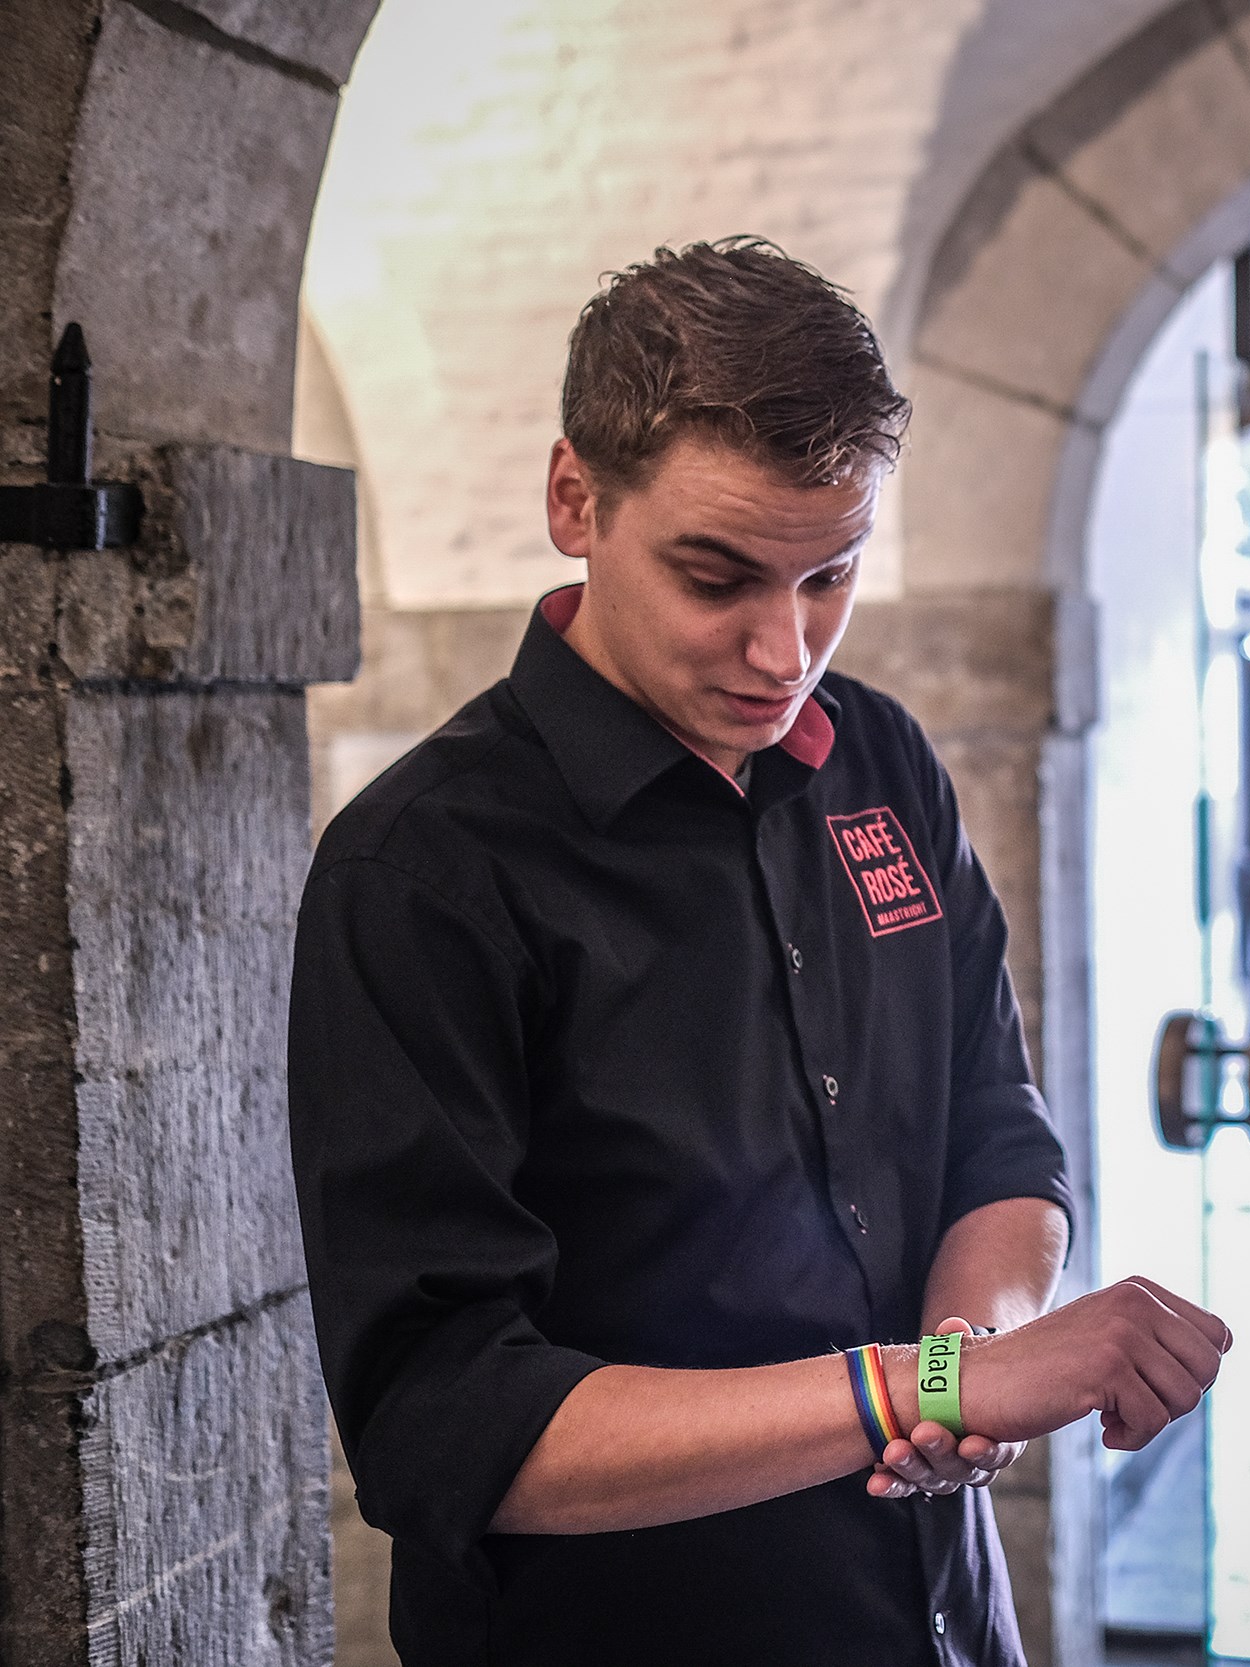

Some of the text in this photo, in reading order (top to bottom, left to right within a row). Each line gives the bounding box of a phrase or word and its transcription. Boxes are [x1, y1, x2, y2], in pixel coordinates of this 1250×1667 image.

[841, 814, 902, 862] CAFÉ
[860, 854, 922, 905] ROSÉ
[920, 1335, 956, 1393] rdag
